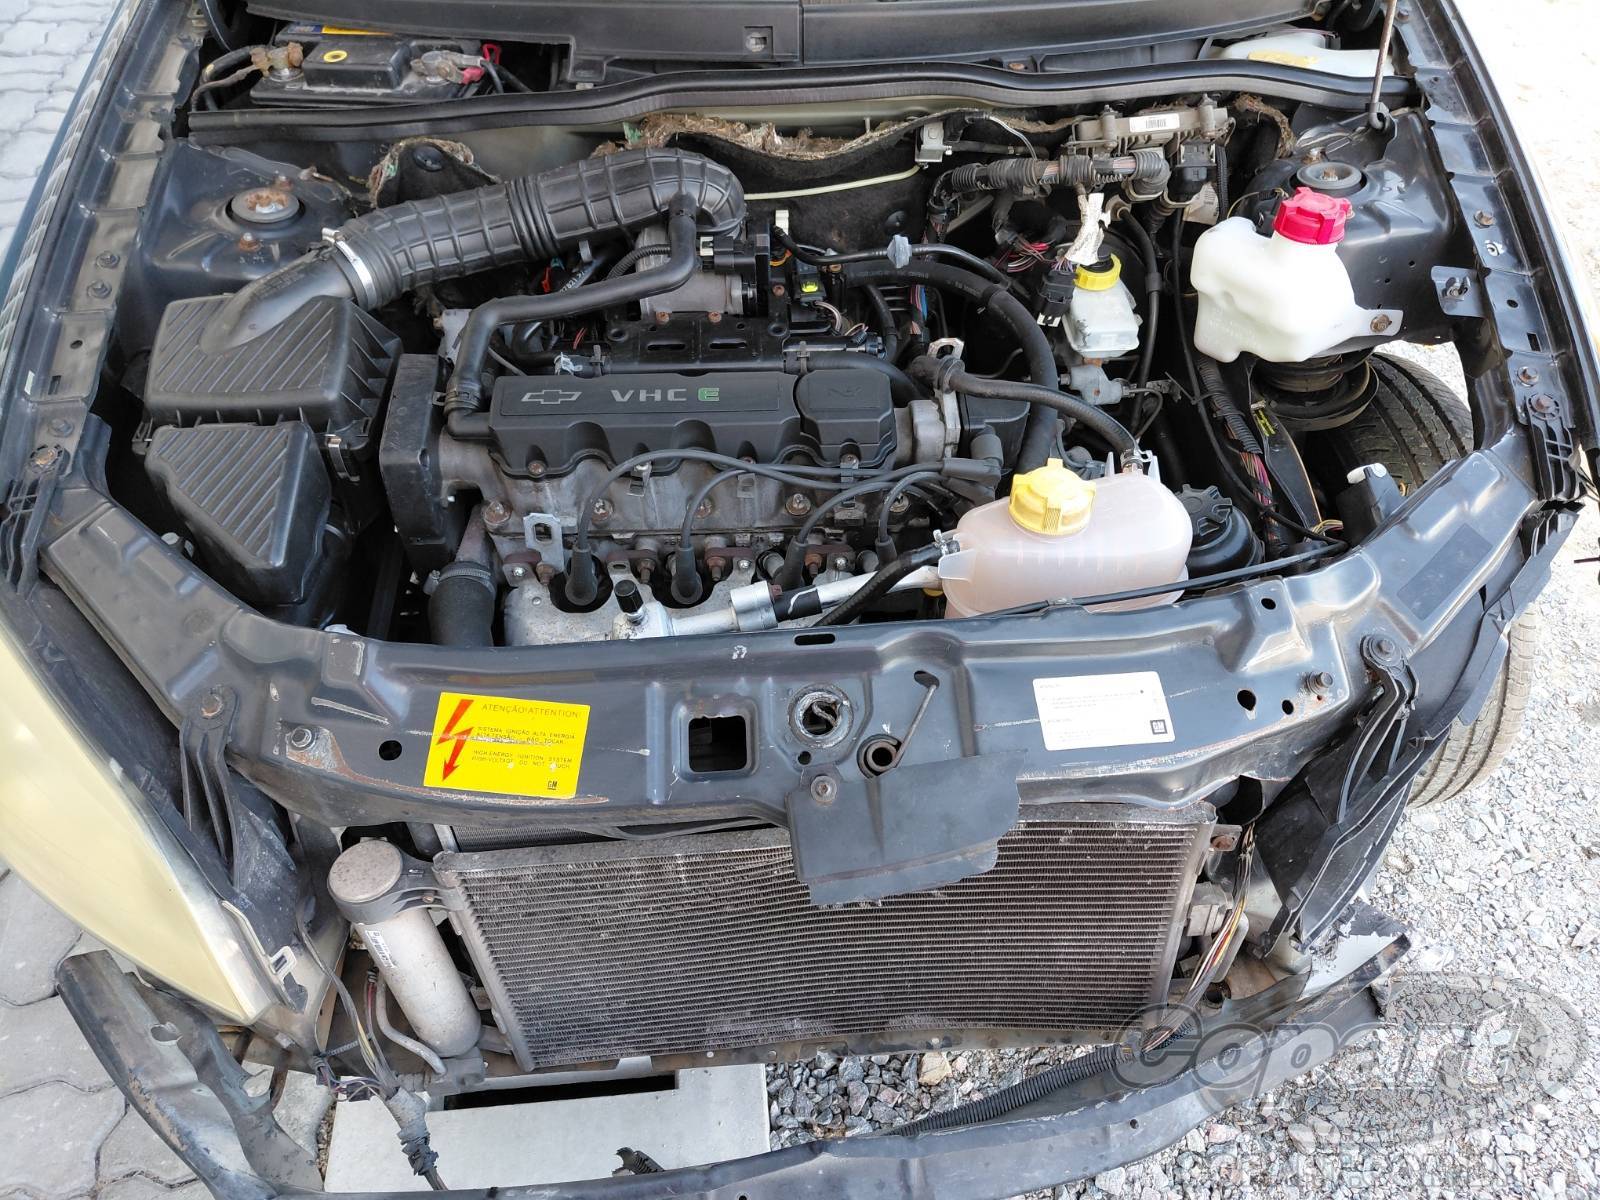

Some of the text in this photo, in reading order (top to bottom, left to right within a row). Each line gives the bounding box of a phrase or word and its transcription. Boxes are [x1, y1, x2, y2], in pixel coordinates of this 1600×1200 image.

[610, 388, 687, 402] VHC
[550, 732, 575, 740] ENERGIA
[547, 780, 558, 789] GM
